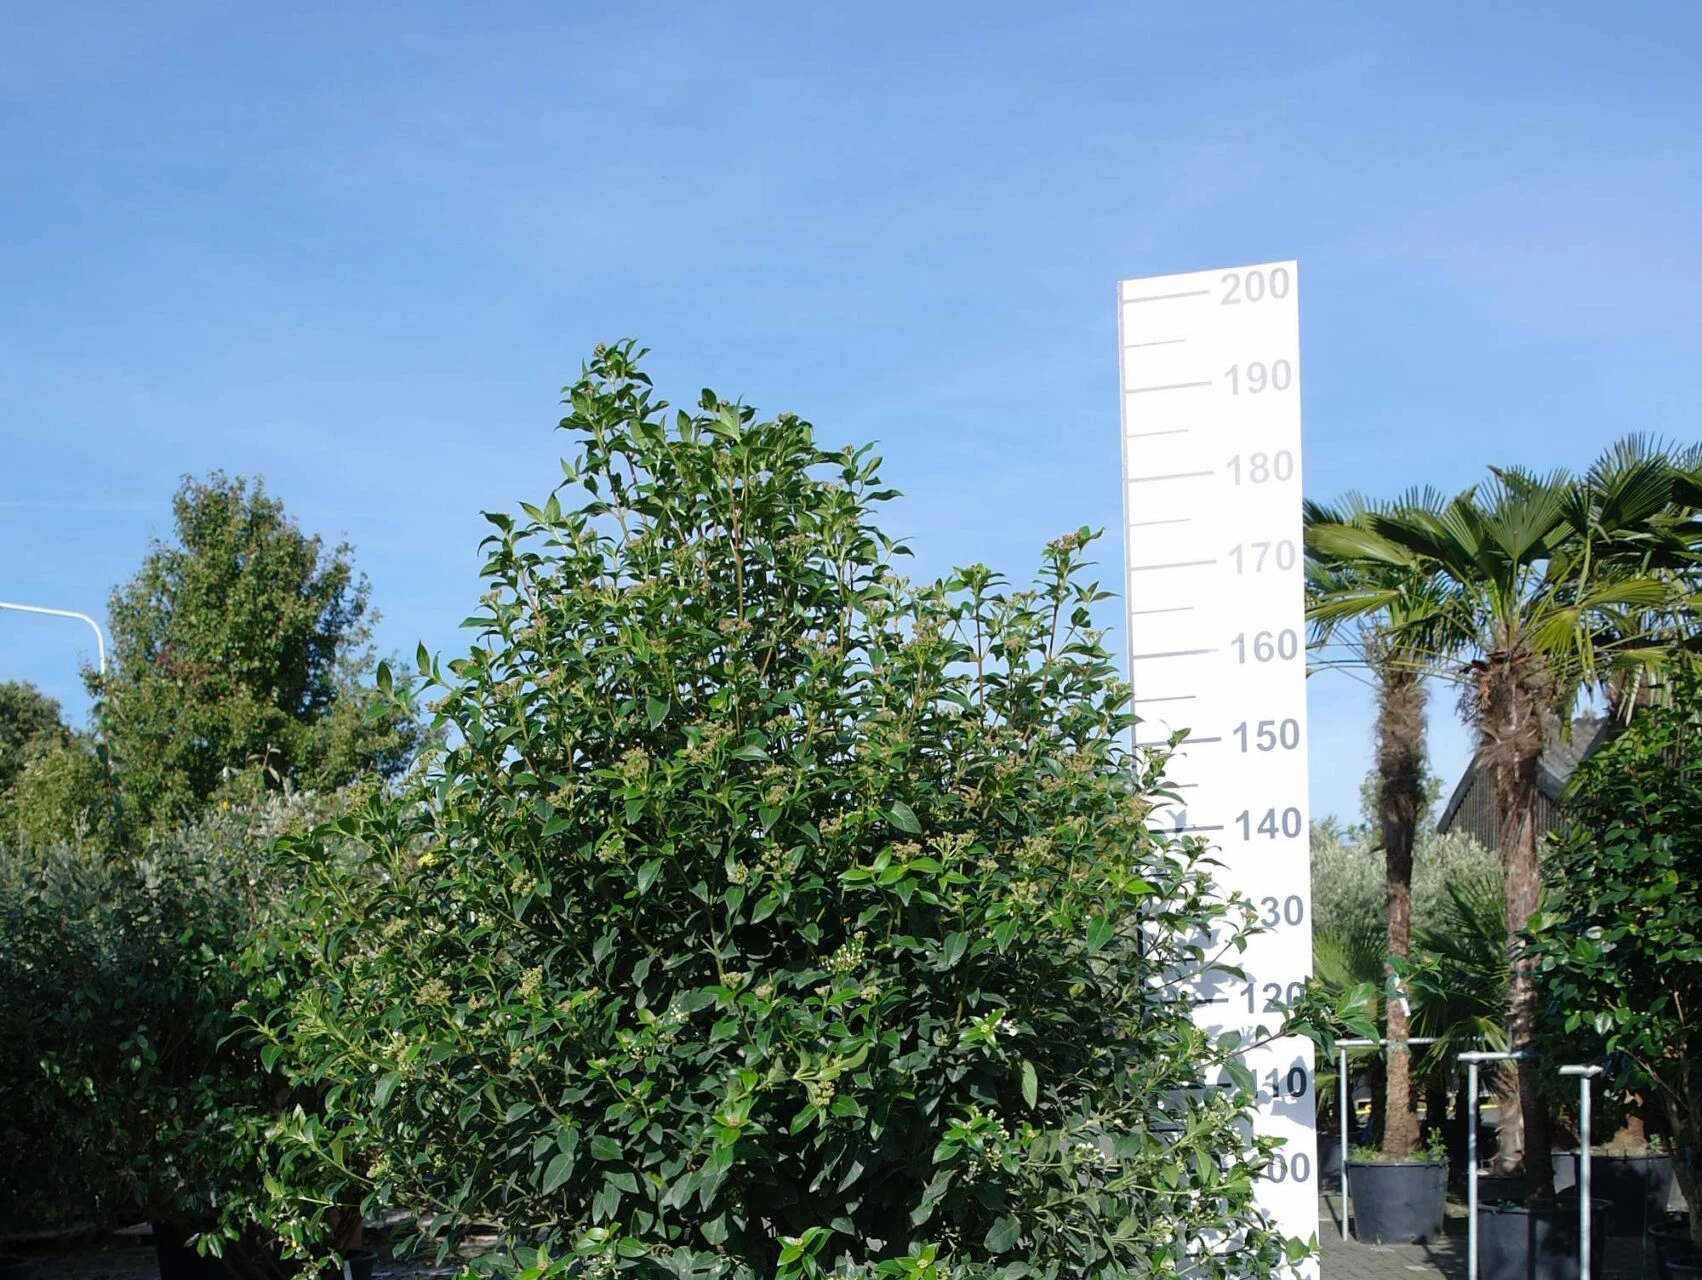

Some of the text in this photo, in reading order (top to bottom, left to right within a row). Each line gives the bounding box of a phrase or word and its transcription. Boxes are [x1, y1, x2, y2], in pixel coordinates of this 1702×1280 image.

[1220, 267, 1290, 305] 200
[1224, 359, 1292, 395] 190
[1226, 450, 1294, 486] 180
[1228, 540, 1296, 575] 170
[1231, 629, 1298, 664] 160
[1233, 718, 1300, 753] 150
[1235, 807, 1302, 841] 140
[1246, 896, 1304, 928] 30
